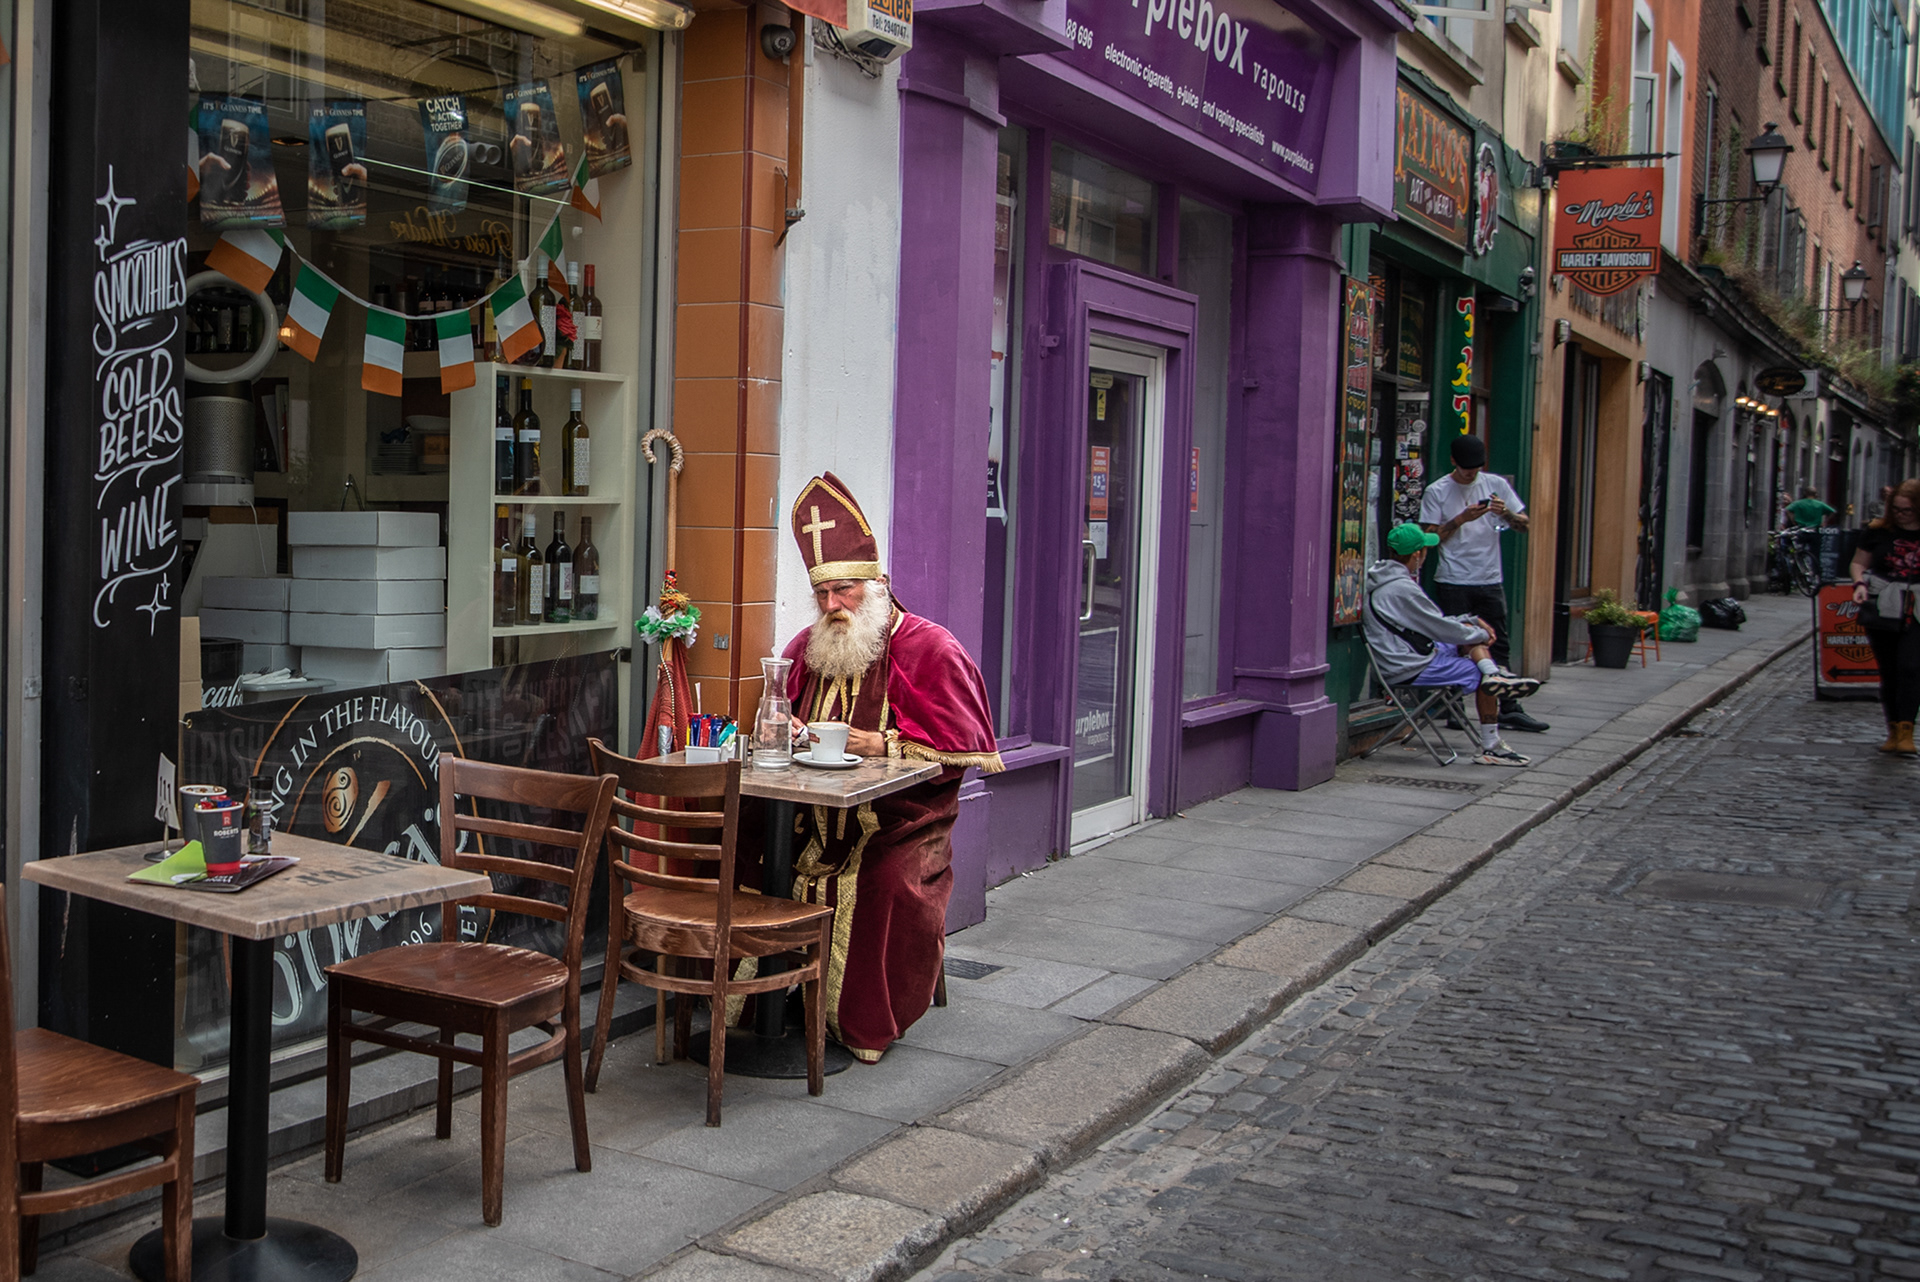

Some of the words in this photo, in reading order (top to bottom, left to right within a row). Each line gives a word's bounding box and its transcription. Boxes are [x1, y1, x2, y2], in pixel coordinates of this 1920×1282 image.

[1077, 25, 1093, 50] 696
[1253, 62, 1306, 113] vapours
[202, 102, 214, 111] IT'S
[220, 105, 248, 114] GUINNESS
[248, 106, 262, 115] TIME
[329, 109, 353, 117] GUINNESS
[353, 109, 364, 117] TIME
[425, 97, 460, 114] CATCH
[1105, 43, 1142, 77] electronic
[1142, 64, 1174, 99] cigarette,
[1177, 85, 1199, 109] e-juice
[1202, 100, 1215, 118] and
[1215, 109, 1236, 134] vaping
[1235, 118, 1265, 146] specialists
[1271, 140, 1314, 174] www.purplebox.ie
[430, 121, 463, 132] TOGETHER
[1394, 86, 1470, 217] TATTOOS
[1409, 177, 1424, 205] ART
[1564, 190, 1654, 228] Murphy's
[1582, 232, 1631, 249] MOTOR
[1561, 252, 1651, 268] HARLEY-DAVIDSON
[1580, 271, 1628, 289] CYCLES
[93, 236, 188, 357] SMOOTHIES
[103, 348, 173, 421] COLD
[99, 386, 184, 474] BEERS
[101, 473, 182, 580] WINE
[1826, 635, 1870, 645] HARLEY-DAV
[290, 725, 318, 771] IN
[319, 695, 364, 738] THE
[1075, 709, 1110, 738] urplebox
[213, 827, 239, 837] ROBERTS
[223, 816, 231, 825] R
